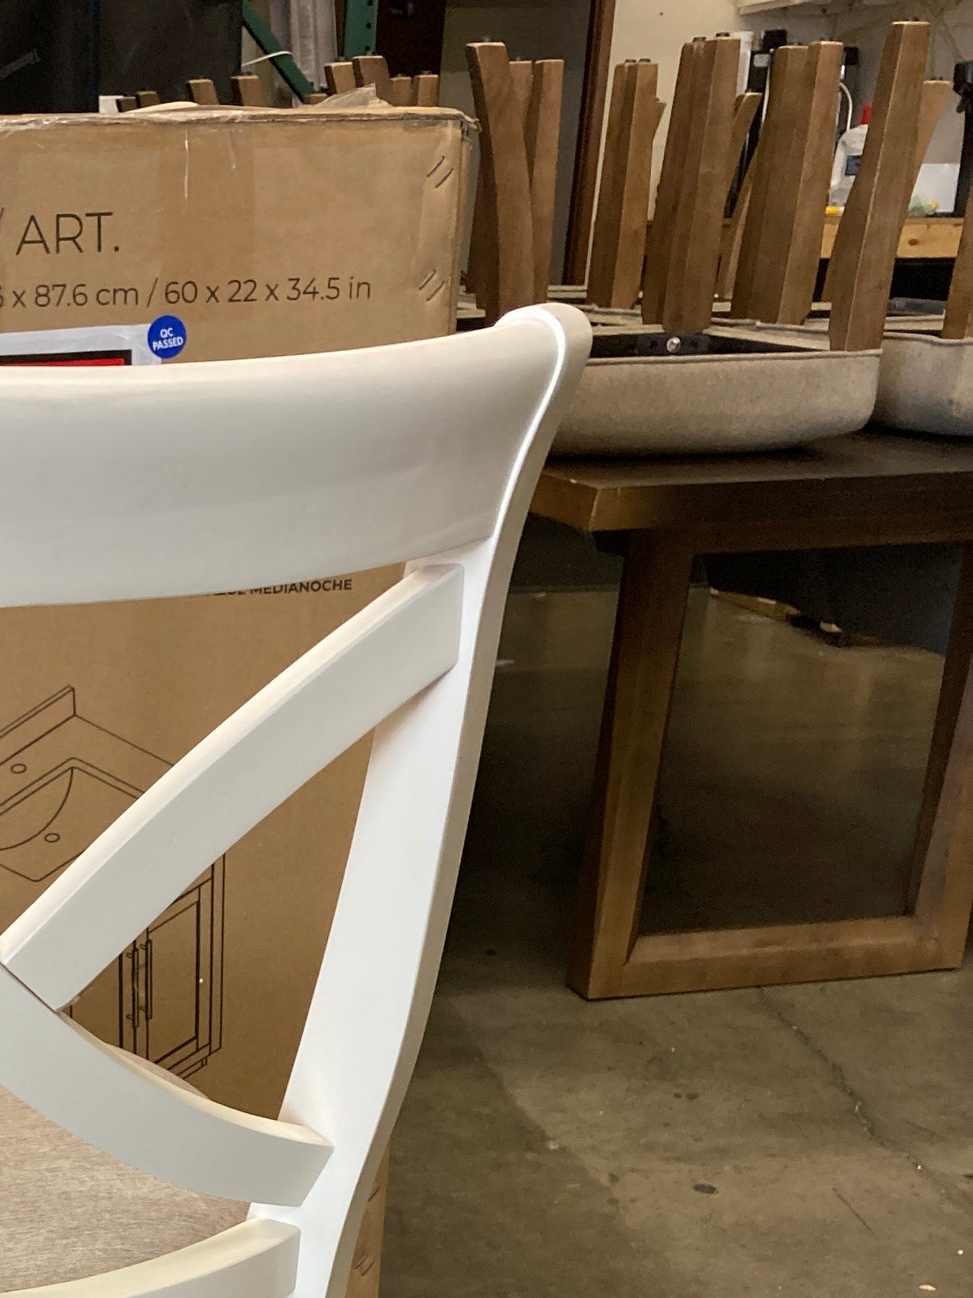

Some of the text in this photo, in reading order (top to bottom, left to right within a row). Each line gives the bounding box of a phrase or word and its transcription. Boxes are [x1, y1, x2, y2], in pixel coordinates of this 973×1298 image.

[15, 211, 120, 255] ART.
[12, 290, 26, 308] x
[35, 283, 88, 308] 87.6
[95, 286, 139, 306] cm
[146, 278, 159, 308] /
[164, 280, 198, 304] 60
[205, 285, 221, 303] x
[228, 279, 258, 302] 22
[264, 282, 280, 302] x
[286, 277, 341, 301] 34.5
[348, 276, 371, 300] in
[159, 326, 175, 338] QC
[151, 337, 184, 351] PASSED
[250, 578, 353, 595] MEDIANOCHE
